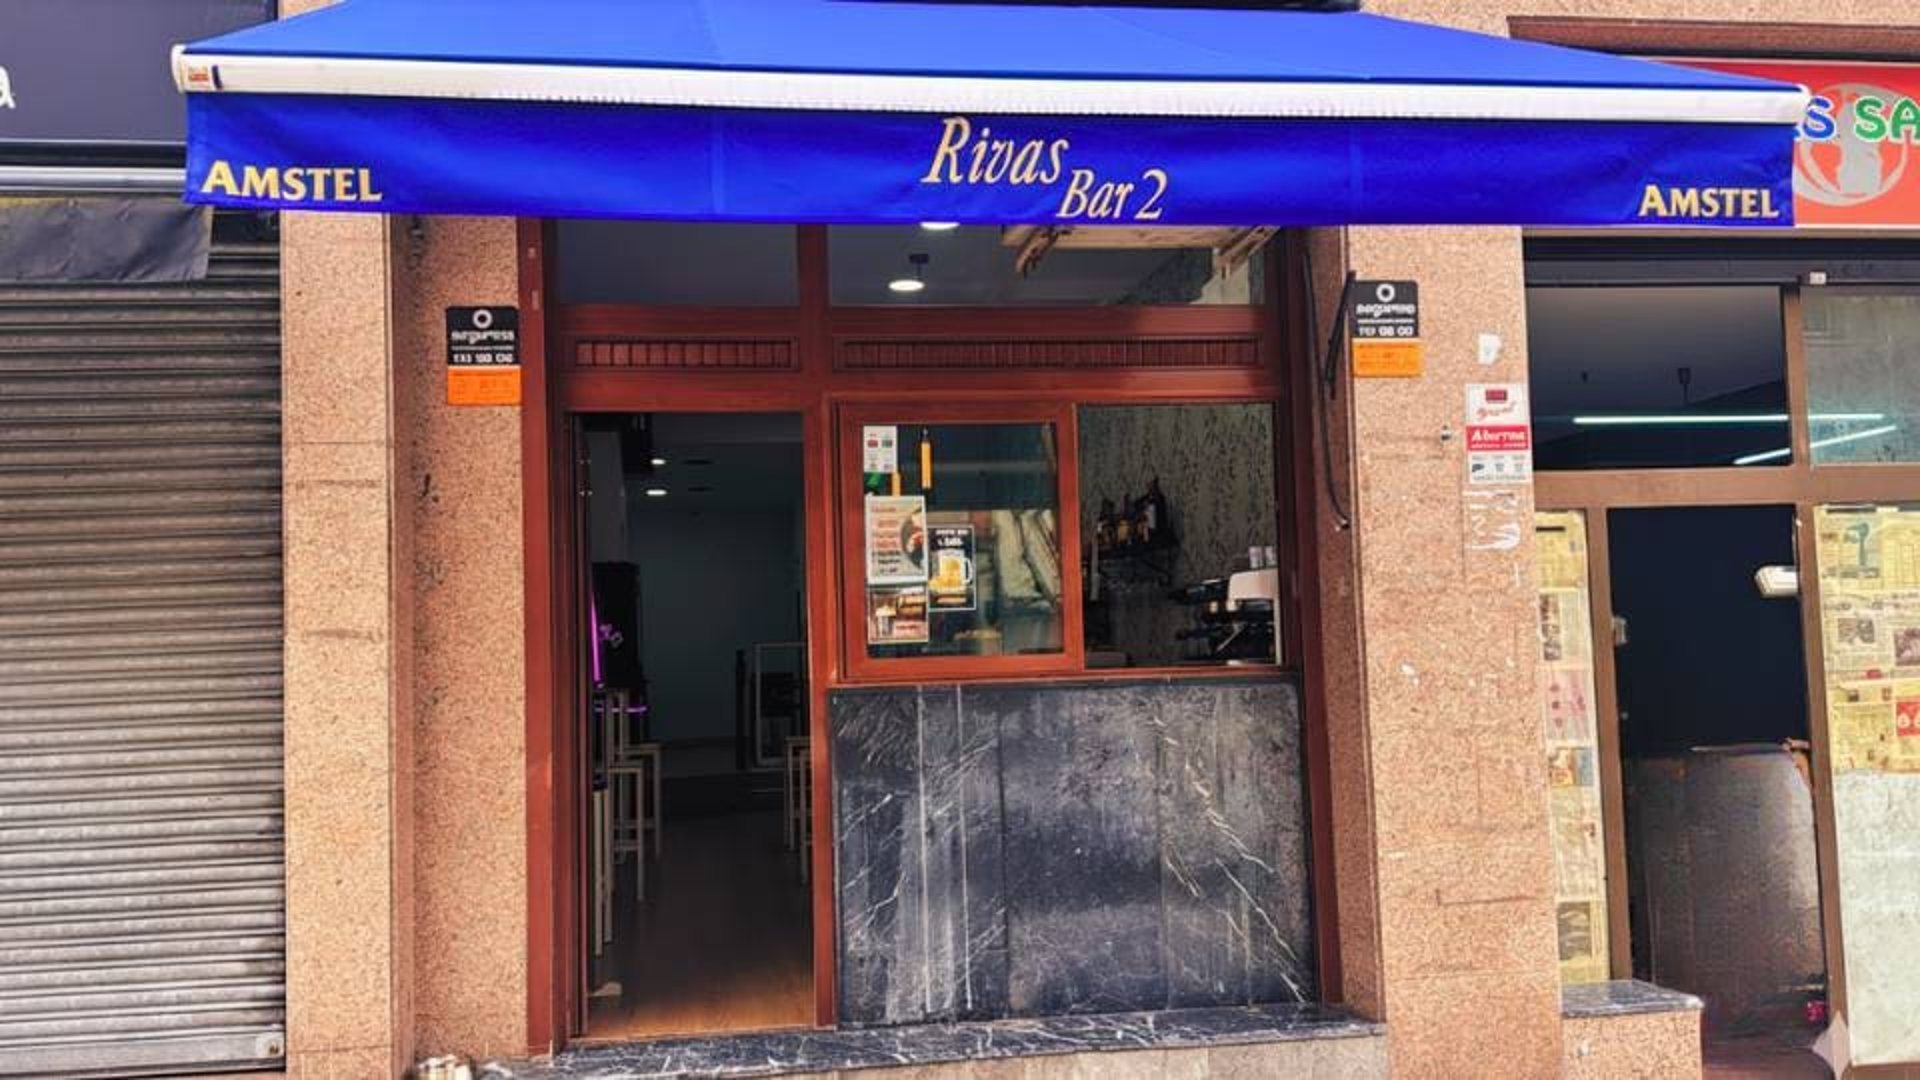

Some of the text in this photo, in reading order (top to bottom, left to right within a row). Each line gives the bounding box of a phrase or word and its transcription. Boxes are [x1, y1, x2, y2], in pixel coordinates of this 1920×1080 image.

[920, 116, 1070, 184] Rivas
[200, 160, 383, 203] AMSTEL
[1056, 168, 1168, 220] Bar 2
[1638, 184, 1780, 219] AMSTEL
